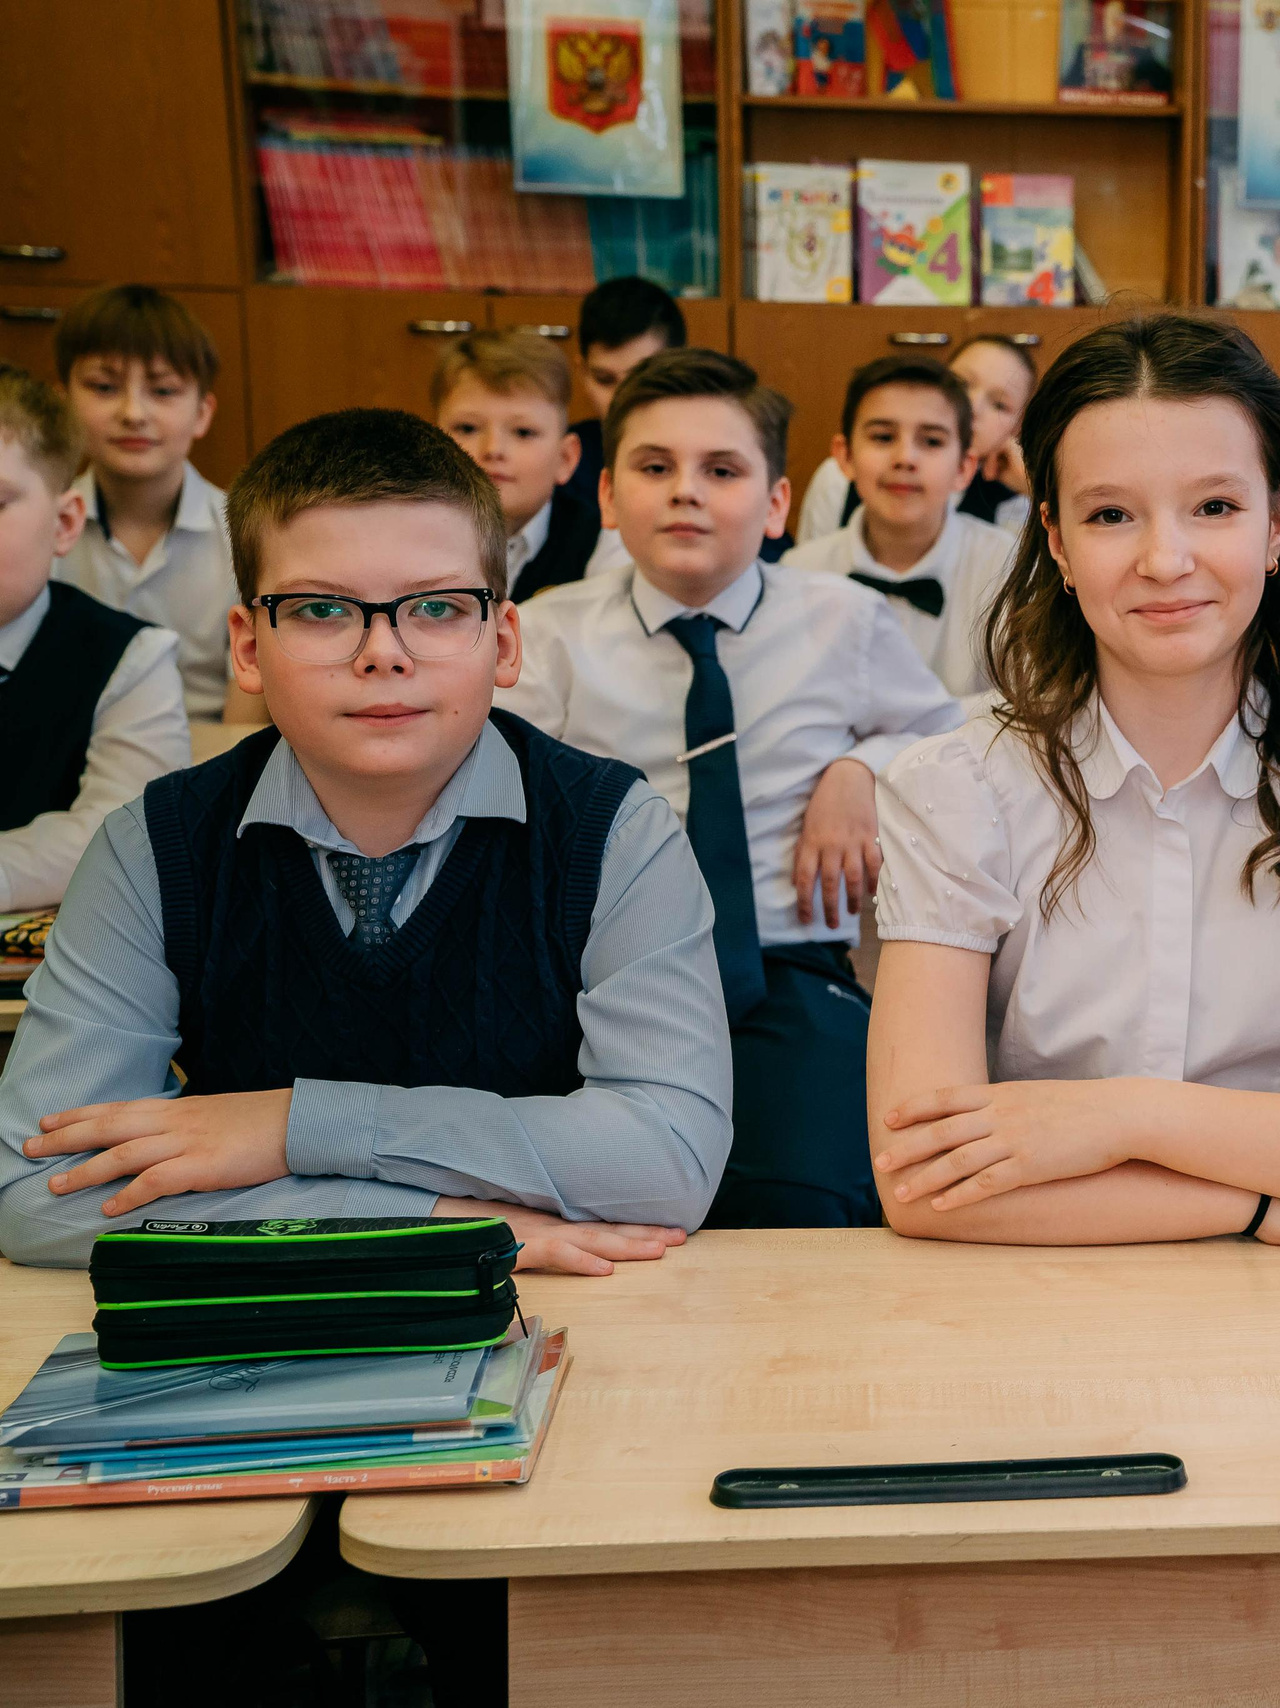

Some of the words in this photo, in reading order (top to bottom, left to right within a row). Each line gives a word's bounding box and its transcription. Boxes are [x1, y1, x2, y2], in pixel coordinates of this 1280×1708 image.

[928, 232, 961, 283] 4
[1026, 270, 1054, 304] 4
[147, 1484, 193, 1496] Русский
[323, 1475, 356, 1484] Часть
[361, 1473, 368, 1482] 2
